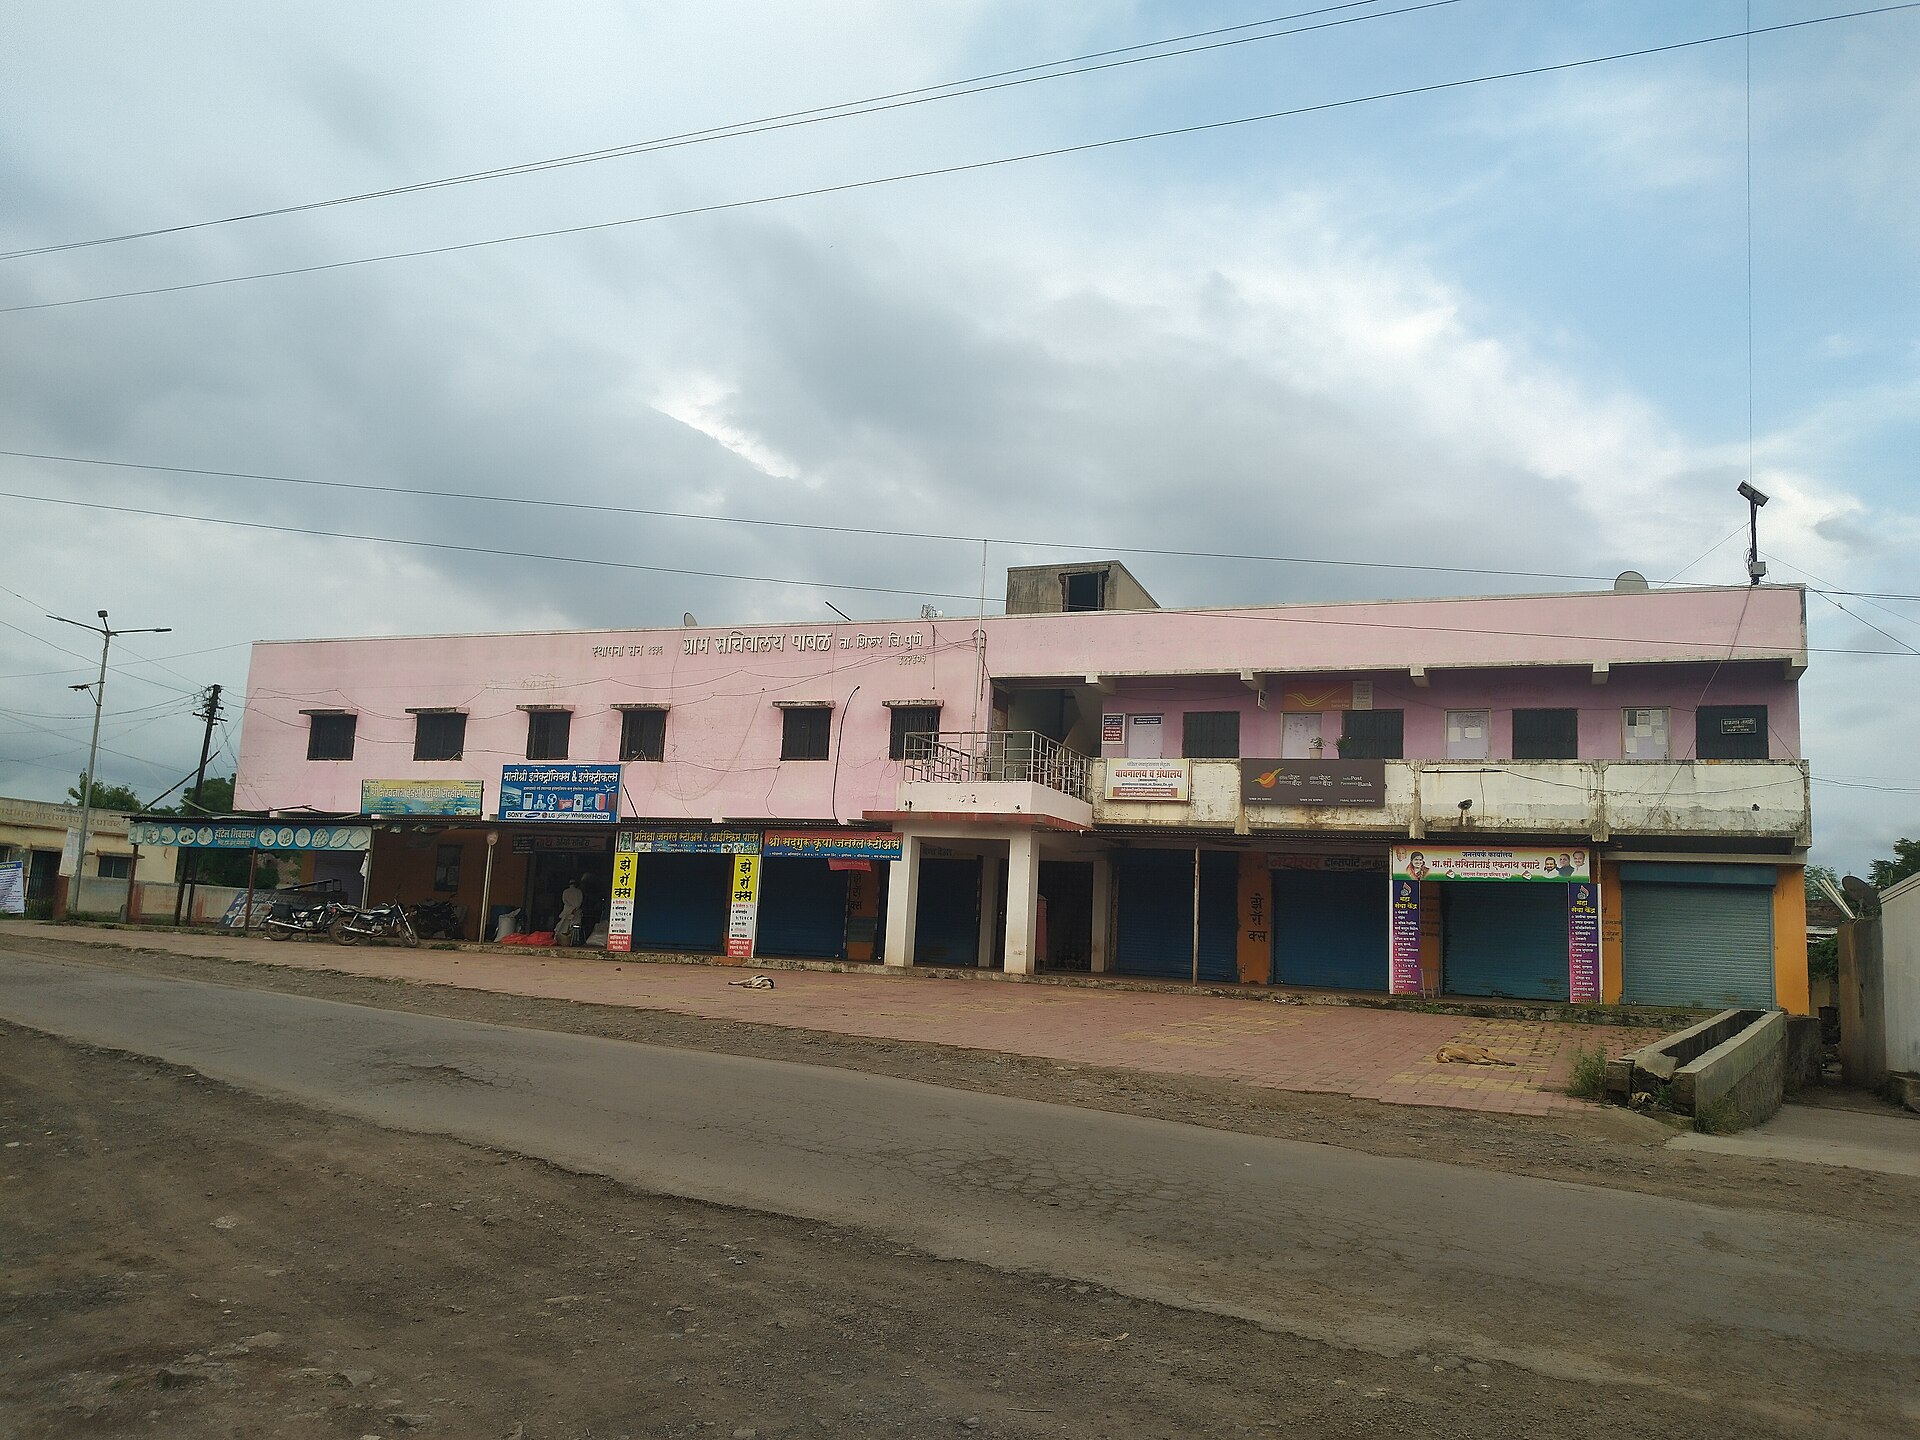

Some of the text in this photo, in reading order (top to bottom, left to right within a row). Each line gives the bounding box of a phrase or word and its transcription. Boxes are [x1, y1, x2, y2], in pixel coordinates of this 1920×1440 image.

[683, 636, 711, 655] ग्राम
[715, 631, 786, 654] सचिवालय
[791, 632, 833, 652] पाबळ
[571, 770, 578, 782] &
[1115, 769, 1148, 778] वाचनालय
[591, 812, 609, 820] Haier
[656, 832, 678, 842] जनरल
[768, 835, 781, 848] श्री
[834, 837, 865, 849] जनरल
[1492, 860, 1519, 871] एकनाथ
